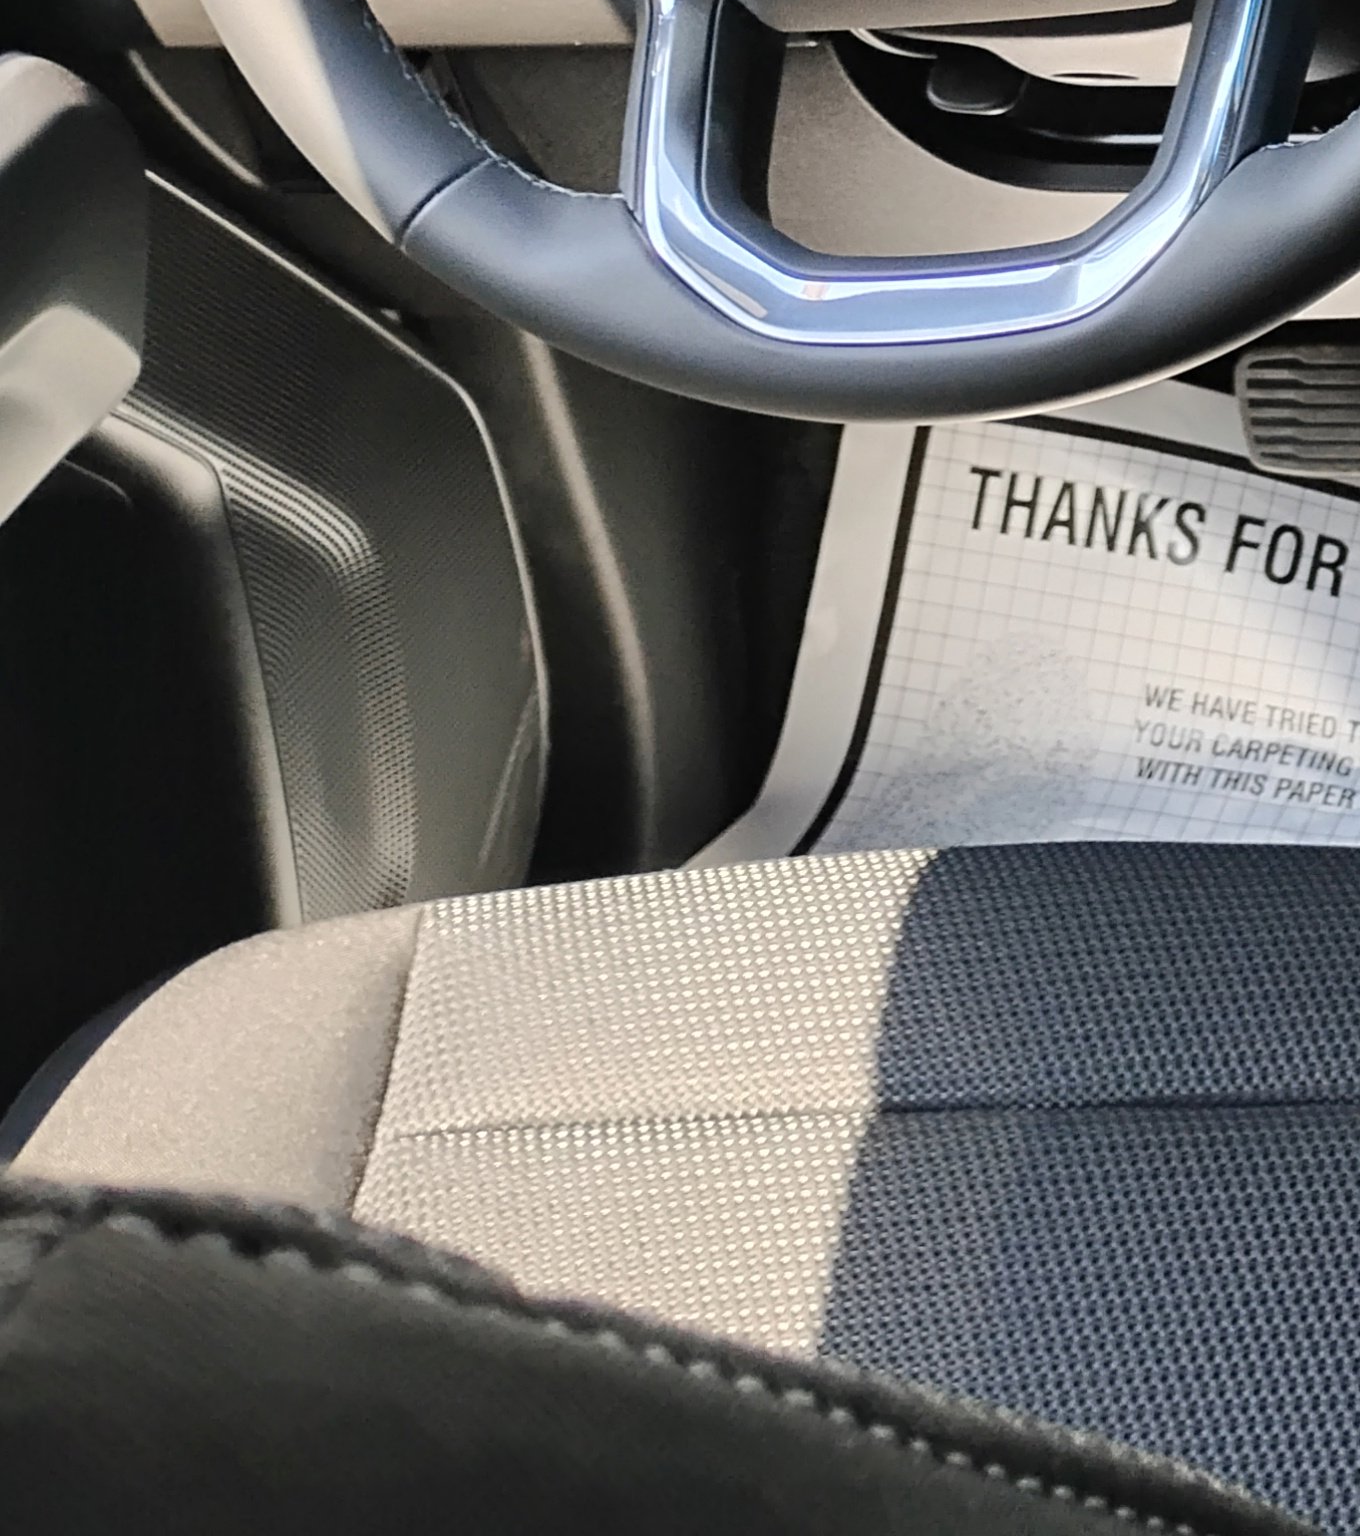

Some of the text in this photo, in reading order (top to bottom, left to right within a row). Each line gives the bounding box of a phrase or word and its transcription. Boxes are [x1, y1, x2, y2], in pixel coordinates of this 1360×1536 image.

[969, 467, 1207, 566] THANKS
[1225, 514, 1349, 598] FOR
[1145, 684, 1184, 713] WE
[1191, 693, 1257, 725] HAVE
[1266, 704, 1338, 739] TRIED
[1134, 718, 1203, 754] YOUR
[1211, 733, 1353, 777] CARPETING
[1137, 757, 1203, 787] WITH
[1210, 767, 1267, 795] THIS
[1274, 777, 1356, 809] PAPER
